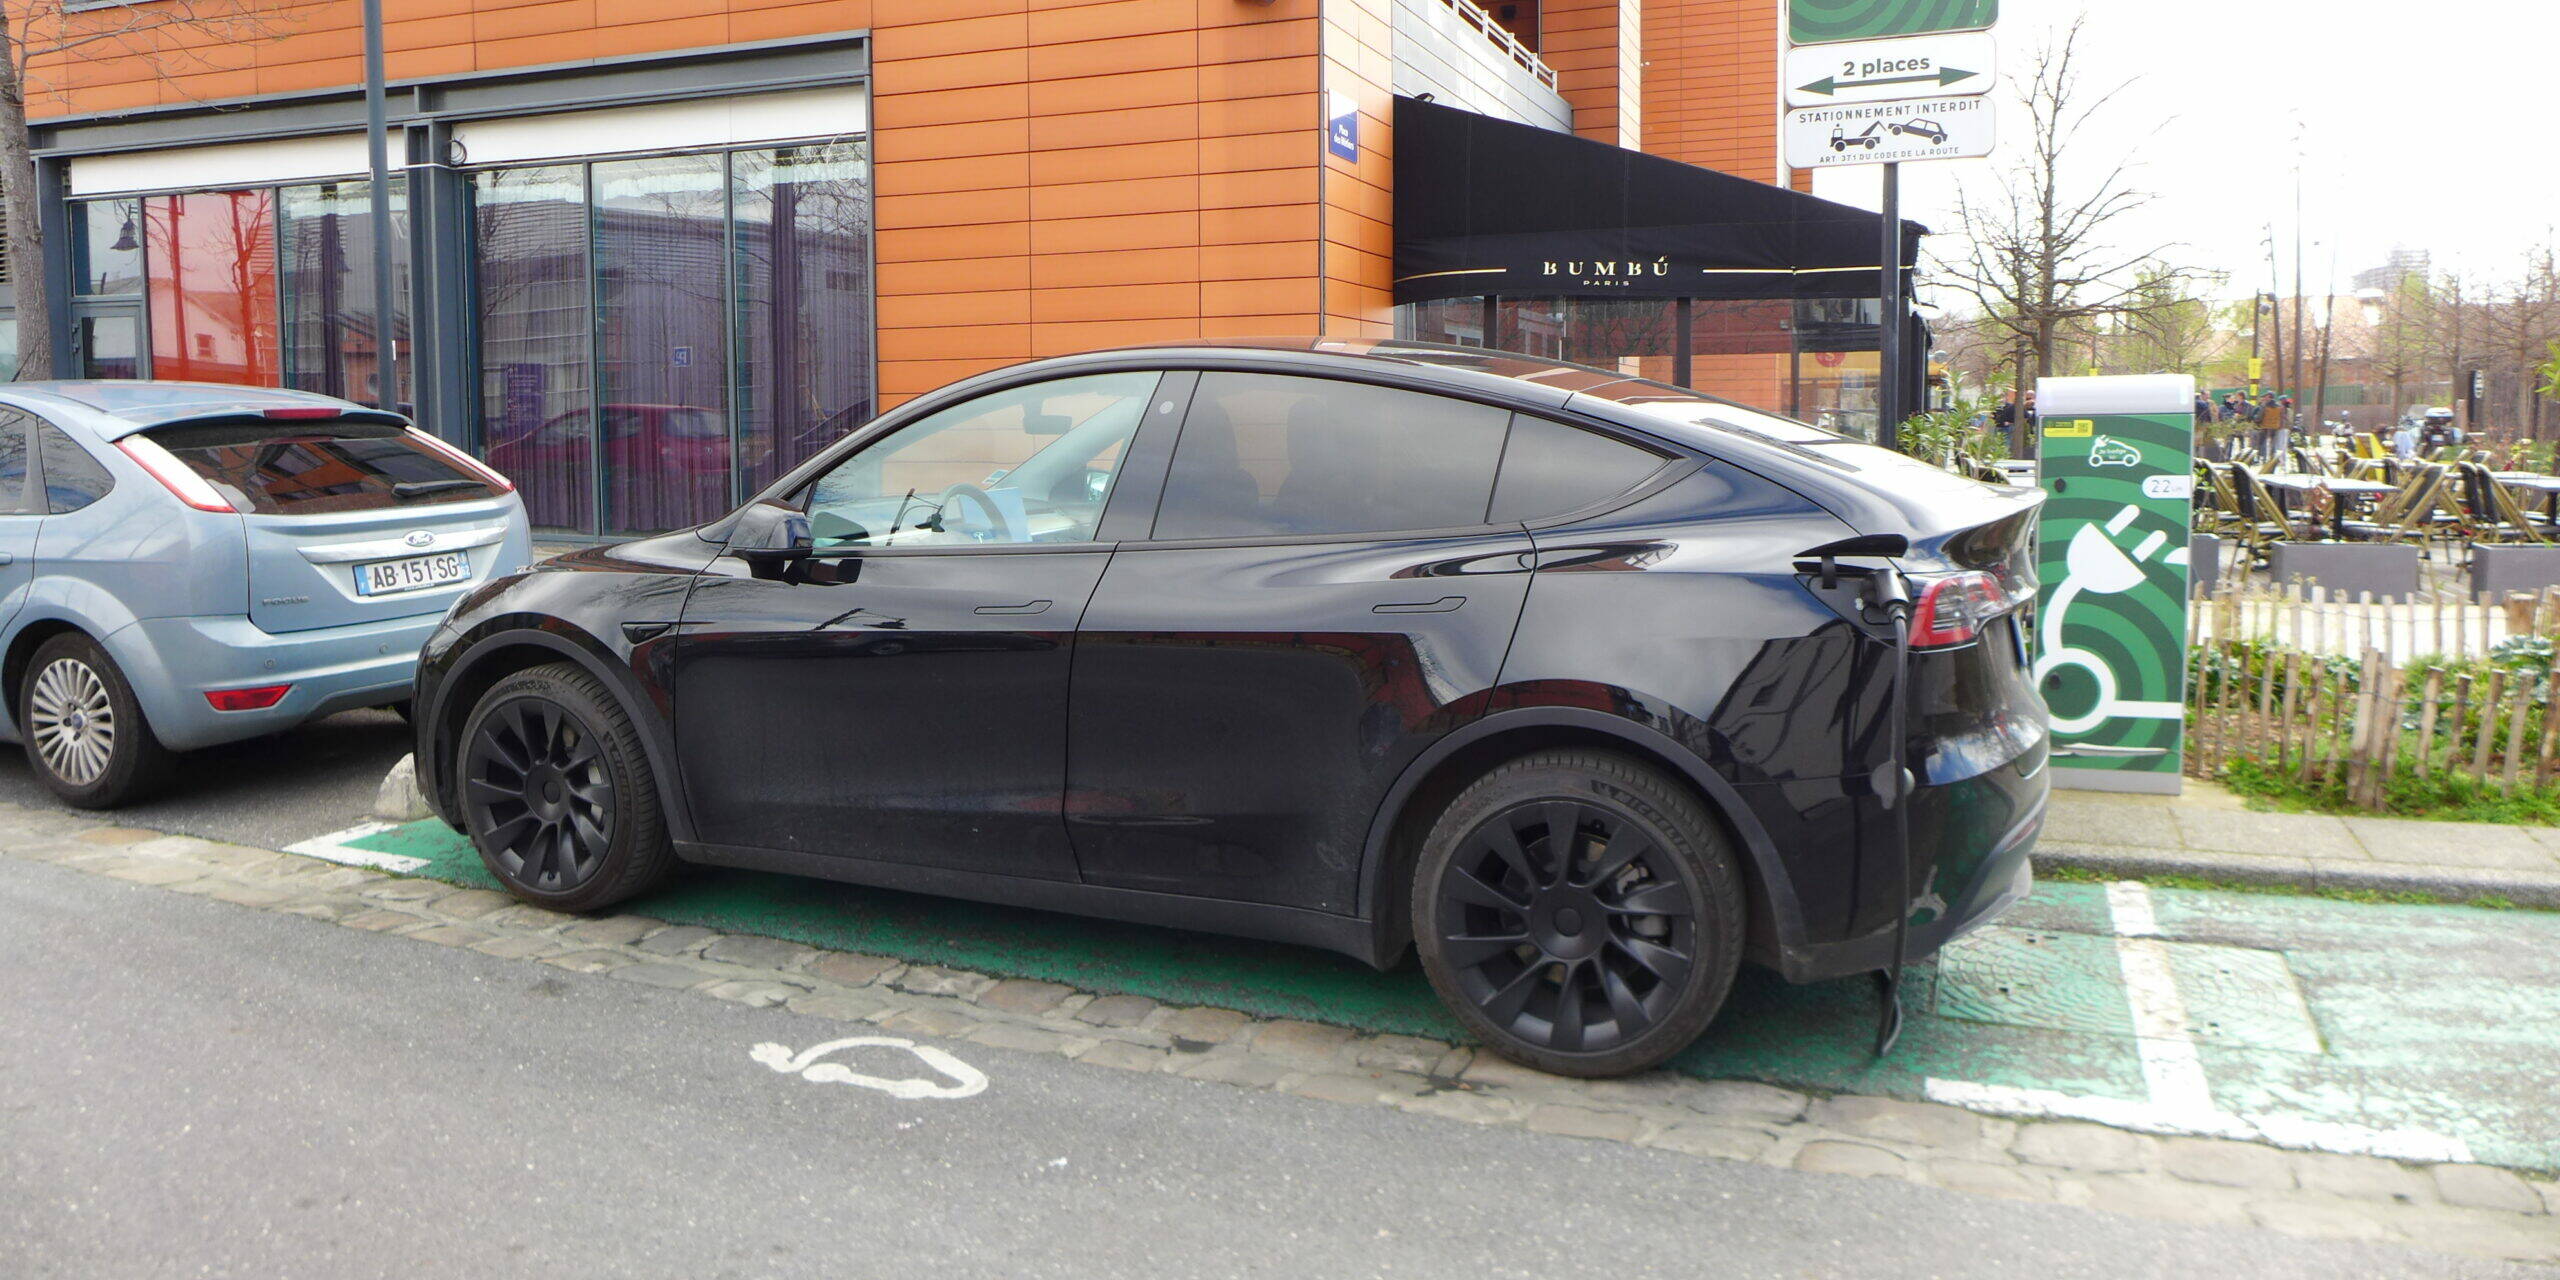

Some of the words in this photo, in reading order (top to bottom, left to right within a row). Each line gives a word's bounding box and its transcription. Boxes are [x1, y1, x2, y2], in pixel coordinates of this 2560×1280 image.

[1843, 61, 1855, 76] 2
[1862, 57, 1930, 78] places
[1799, 105, 1911, 123] STATIONNEMENT
[1916, 100, 1981, 114] INTERDIT
[1859, 153, 1871, 161] DU
[1874, 150, 1898, 160] CODE
[1900, 149, 1912, 158] DE
[1915, 148, 1926, 157] LA
[1929, 146, 1960, 156] ROUTE
[1543, 255, 1668, 276] BUMBÚ
[2151, 479, 2171, 493] 22
